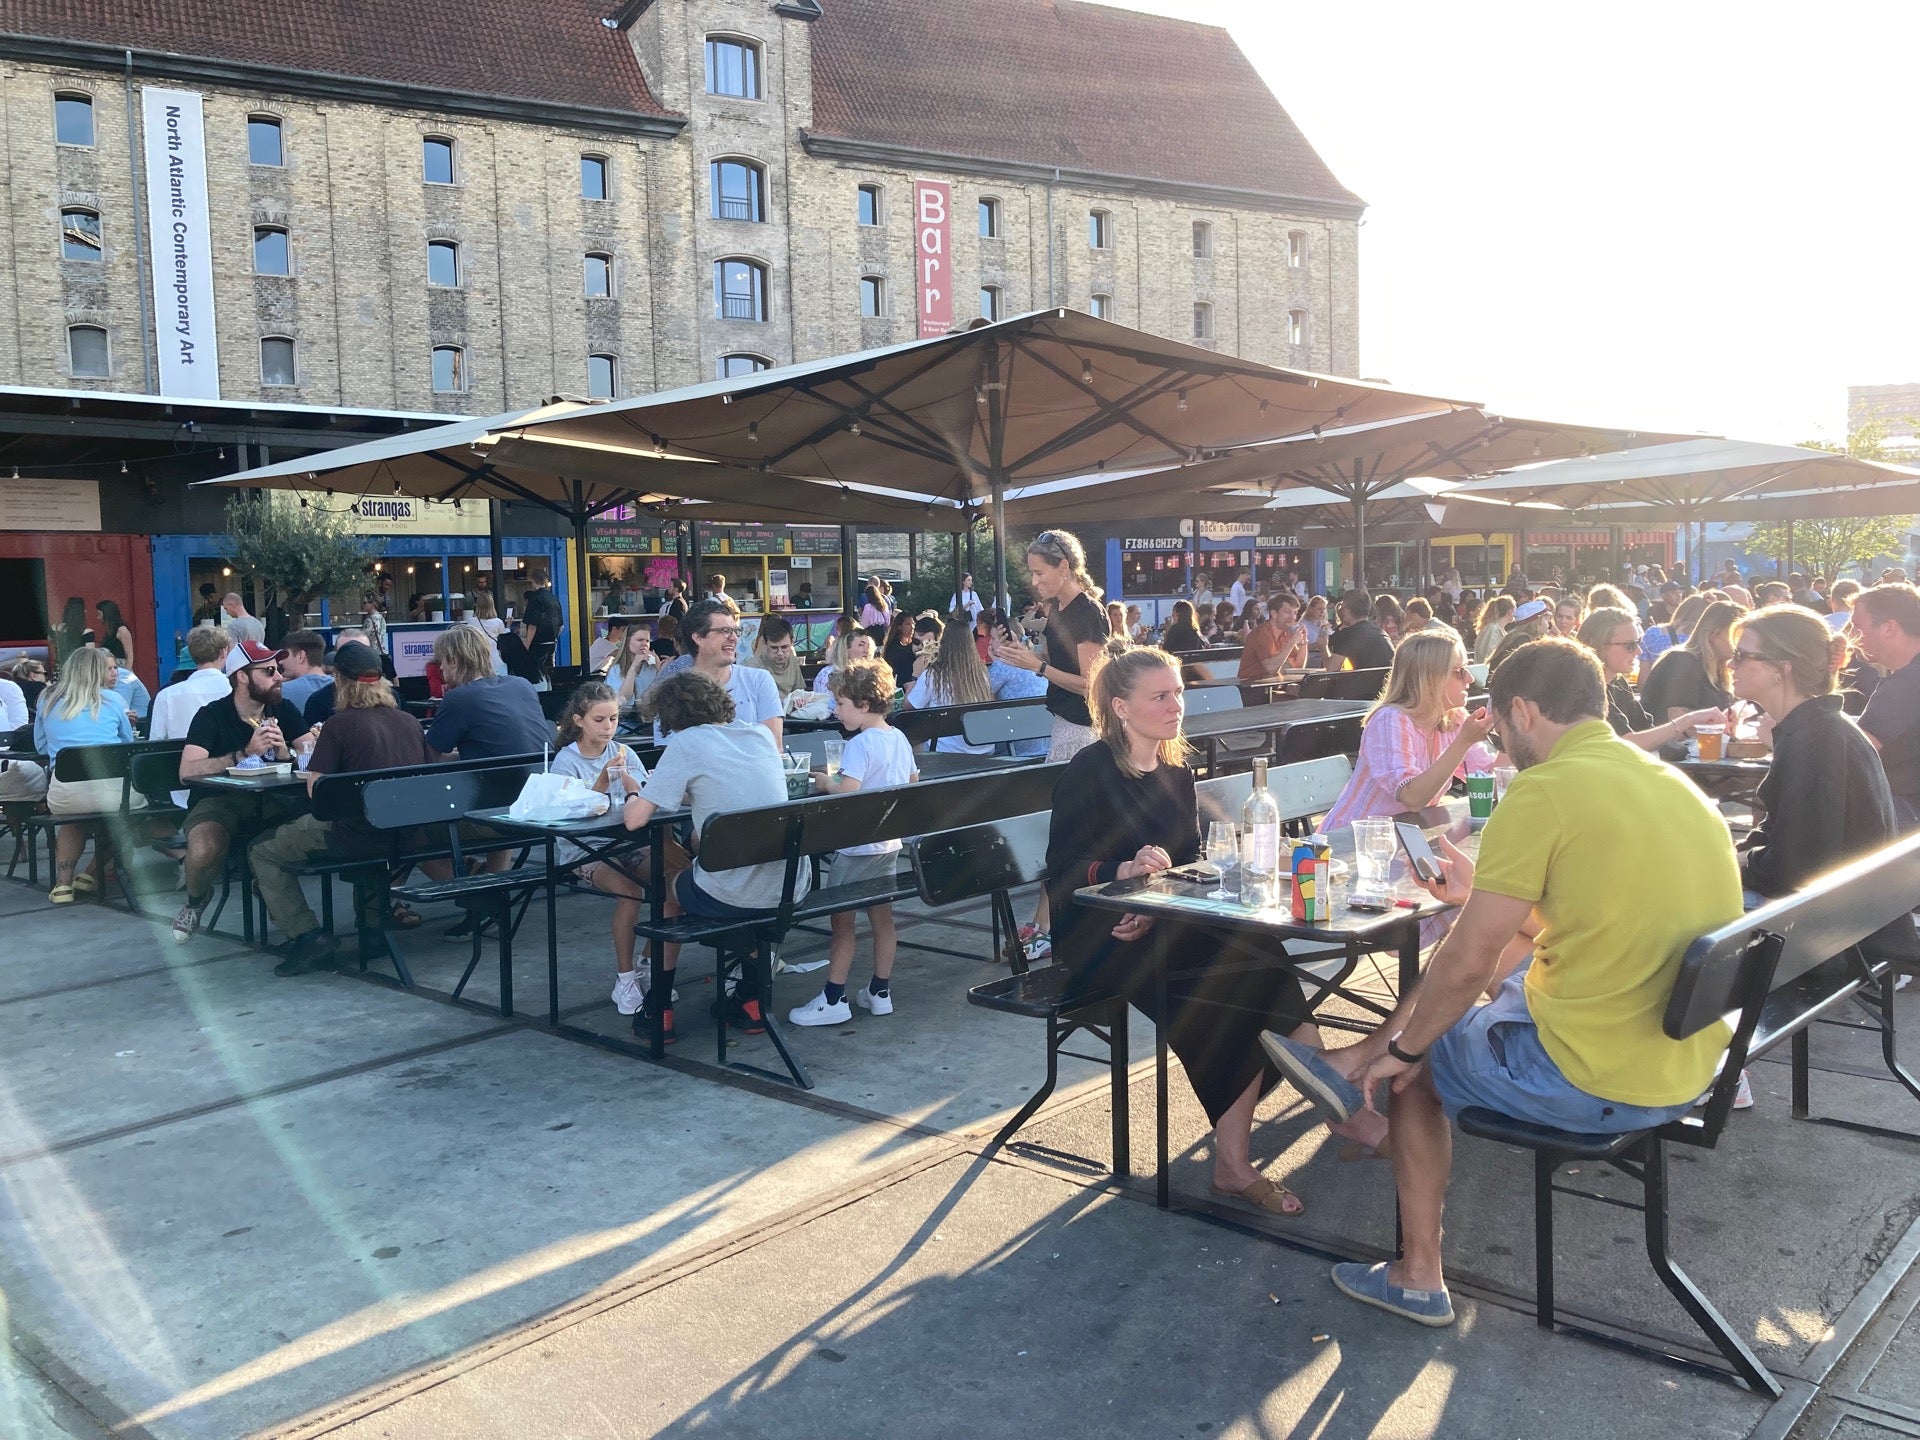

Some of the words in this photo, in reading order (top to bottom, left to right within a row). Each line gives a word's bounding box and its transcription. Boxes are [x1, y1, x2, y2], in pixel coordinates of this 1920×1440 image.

[165, 104, 183, 151] North
[168, 154, 187, 218] Atlantic
[919, 188, 945, 314] Barr
[172, 221, 190, 336] Contemporary
[179, 339, 195, 365] Art
[362, 499, 411, 521] strangas
[1186, 524, 1224, 533] HDOCK'S
[1226, 524, 1255, 533] SEAFOOD
[1256, 536, 1286, 547] MOULES
